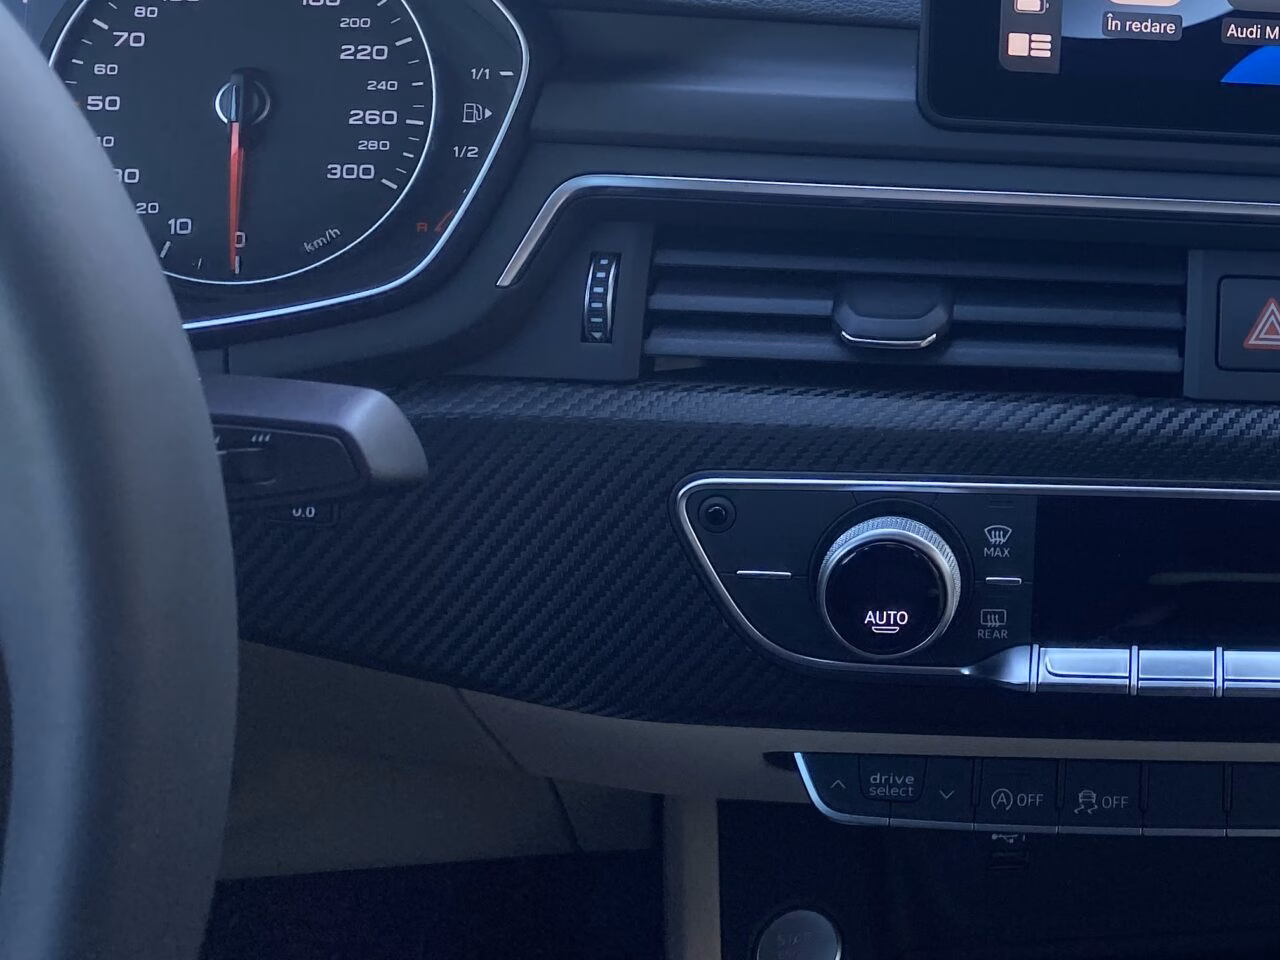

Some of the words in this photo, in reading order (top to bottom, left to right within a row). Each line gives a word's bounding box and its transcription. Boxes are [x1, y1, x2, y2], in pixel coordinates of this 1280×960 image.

[134, 6, 158, 18] 80
[339, 17, 371, 28] 200
[1106, 15, 1122, 32] În
[1126, 17, 1176, 34] redare
[1226, 24, 1261, 40] Audi
[112, 32, 145, 47] 70
[339, 45, 389, 60] 220
[94, 64, 118, 75] 60
[470, 68, 490, 80] 1/1
[366, 80, 398, 91] 240
[86, 95, 121, 111] 50
[348, 110, 398, 125] 260
[96, 135, 115, 147] 0
[357, 140, 390, 151] 280
[453, 146, 479, 158] 1/2
[326, 164, 375, 179] 300
[135, 202, 159, 214] 20
[168, 218, 192, 235] 10
[303, 227, 341, 253] km/h
[983, 547, 1011, 558] MAX
[864, 610, 909, 626] AUTO
[977, 628, 1009, 640] REAR
[869, 771, 915, 785] drive
[868, 783, 915, 797] select
[1016, 793, 1045, 807] OFF
[1101, 795, 1129, 809] OFF
